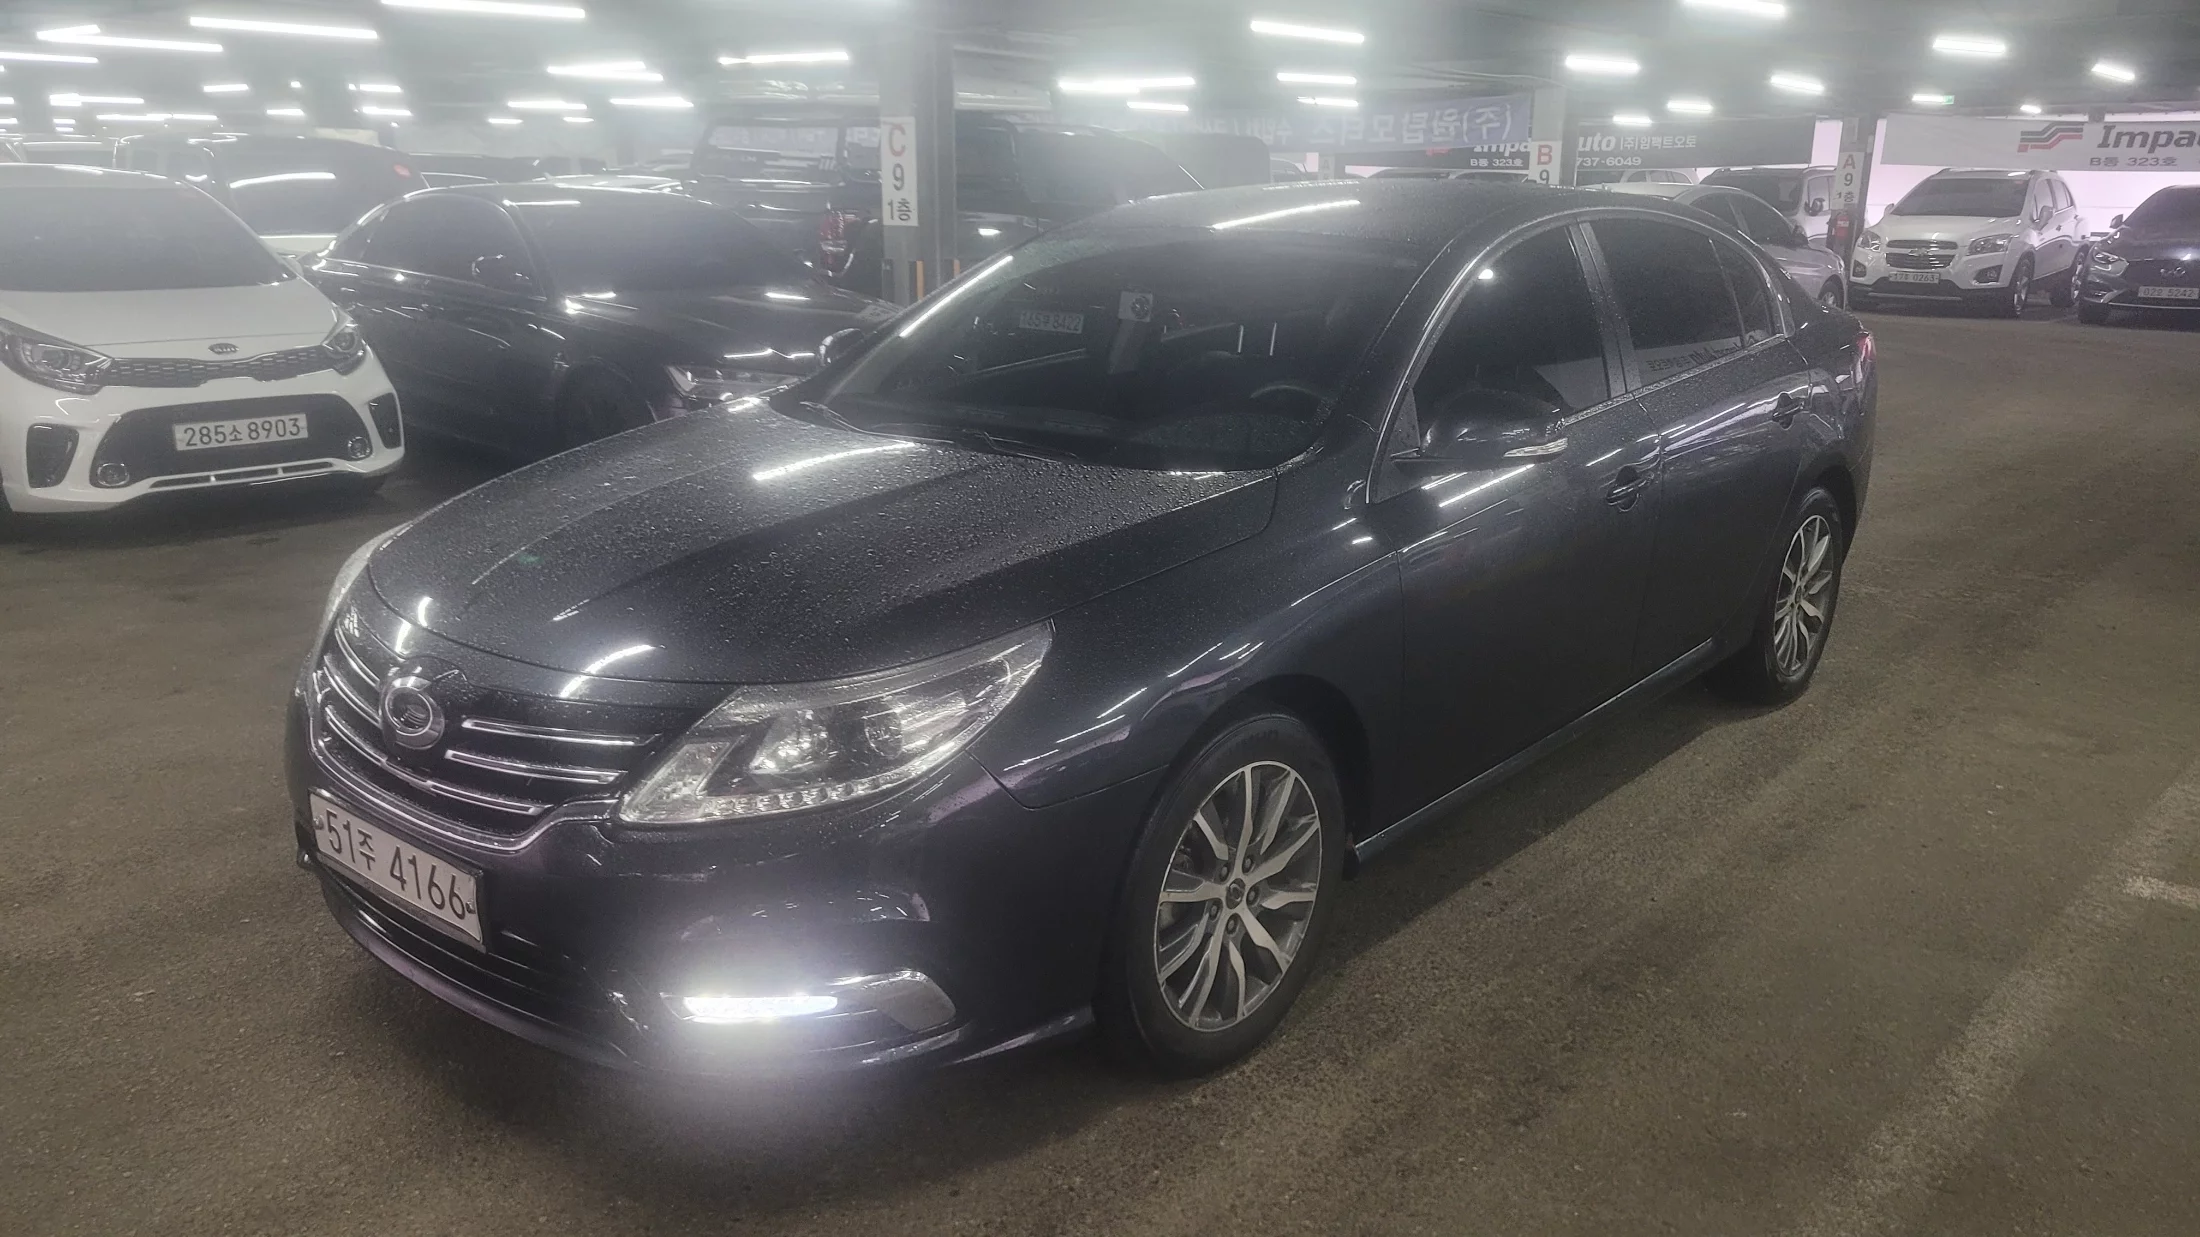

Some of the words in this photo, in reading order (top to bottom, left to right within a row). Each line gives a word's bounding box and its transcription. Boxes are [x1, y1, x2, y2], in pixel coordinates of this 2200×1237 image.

[889, 123, 906, 156] C
[1537, 144, 1552, 165] B
[1843, 154, 1856, 169] A
[892, 163, 904, 191] 9
[1540, 169, 1549, 184] 9
[1844, 173, 1853, 186] 9
[887, 198, 912, 221] 1층
[326, 808, 376, 871] 51주
[389, 844, 466, 920] 4166
